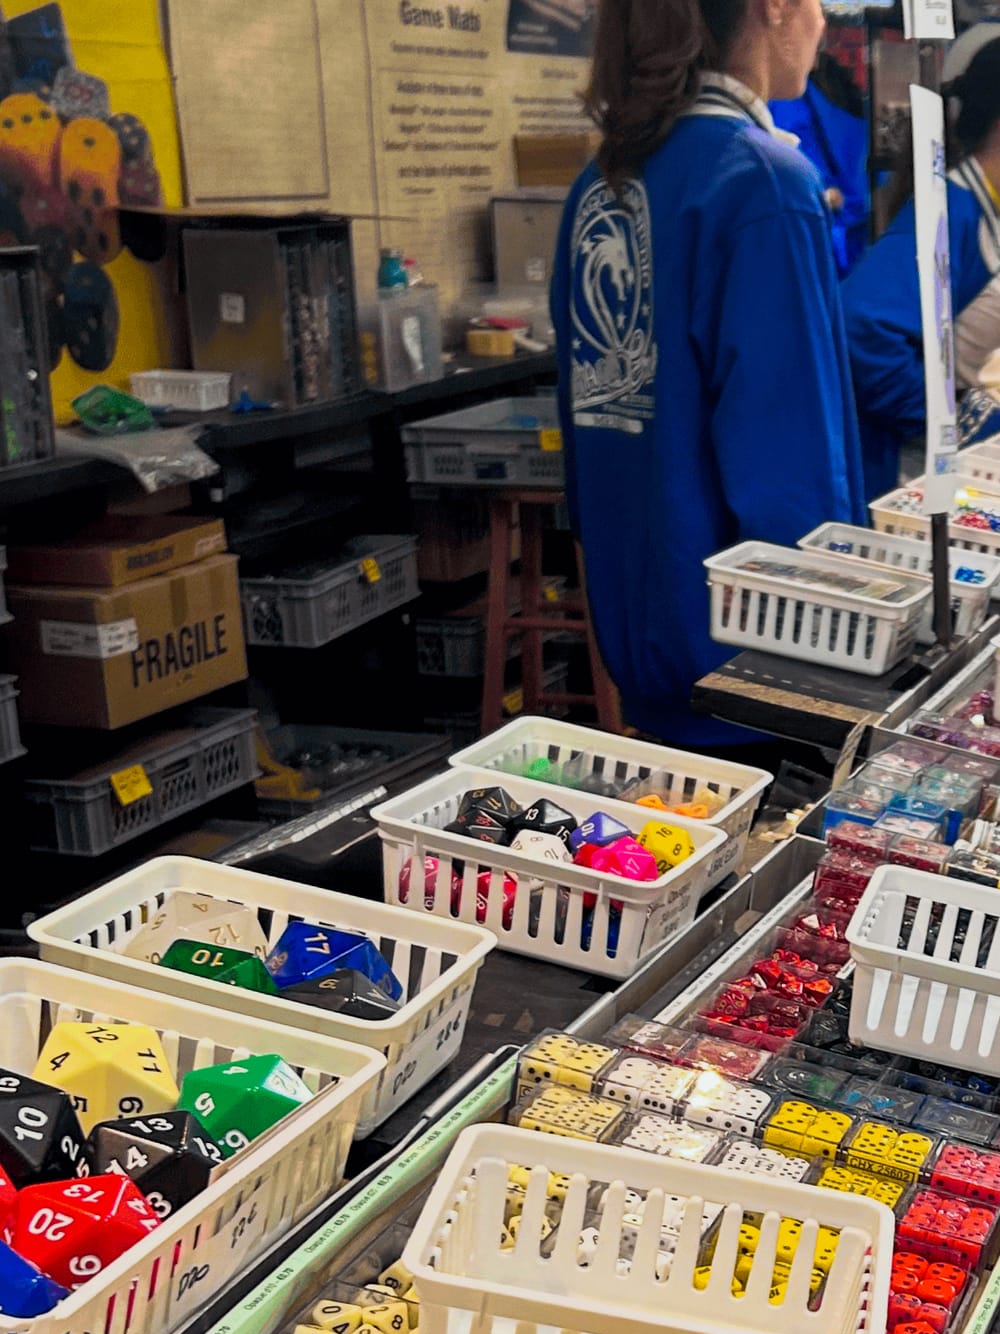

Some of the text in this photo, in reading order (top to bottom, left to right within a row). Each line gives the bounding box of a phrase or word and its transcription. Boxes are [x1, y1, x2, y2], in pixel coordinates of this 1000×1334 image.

[131, 614, 227, 688] FRAGILE
[526, 808, 539, 821] 13
[656, 827, 672, 838] 16
[625, 858, 640, 875] 17
[305, 932, 330, 955] 17
[192, 949, 224, 967] 10
[86, 1026, 119, 1044] 12
[50, 1052, 70, 1071] 4
[137, 1048, 162, 1074] 11
[222, 1066, 249, 1075] 4
[194, 1092, 215, 1117] 5
[14, 1106, 48, 1141] 10
[131, 1118, 174, 1134] 13
[61, 1135, 79, 1161] 2
[850, 1157, 873, 1173] CHX
[63, 1184, 104, 1202] 13
[28, 1208, 74, 1241] 20
